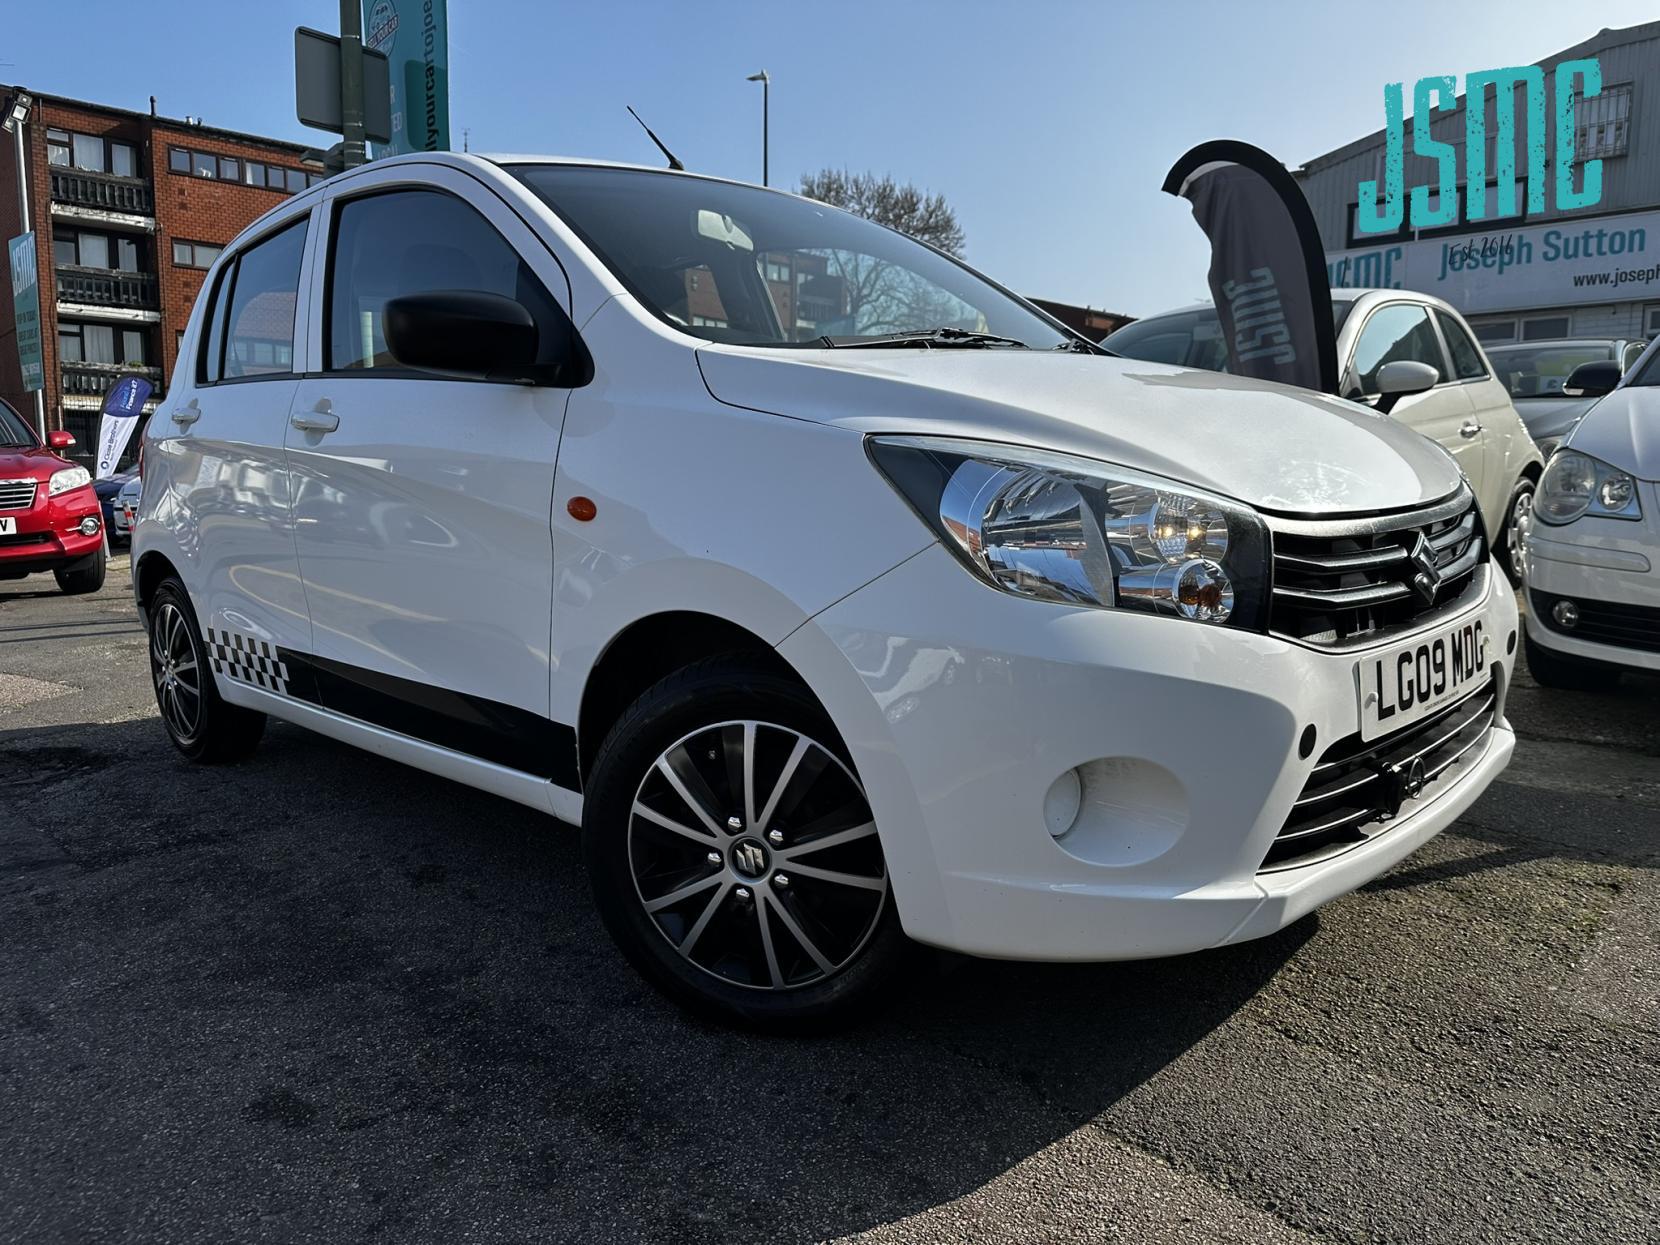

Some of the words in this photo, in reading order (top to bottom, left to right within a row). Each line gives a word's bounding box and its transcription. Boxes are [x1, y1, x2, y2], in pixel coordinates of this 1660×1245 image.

[1437, 234, 1533, 281] Joseph
[1542, 228, 1646, 262] Sutton
[1222, 266, 1296, 365] JSMC
[1376, 638, 1446, 721] LG09
[1451, 619, 1484, 688] MDG
